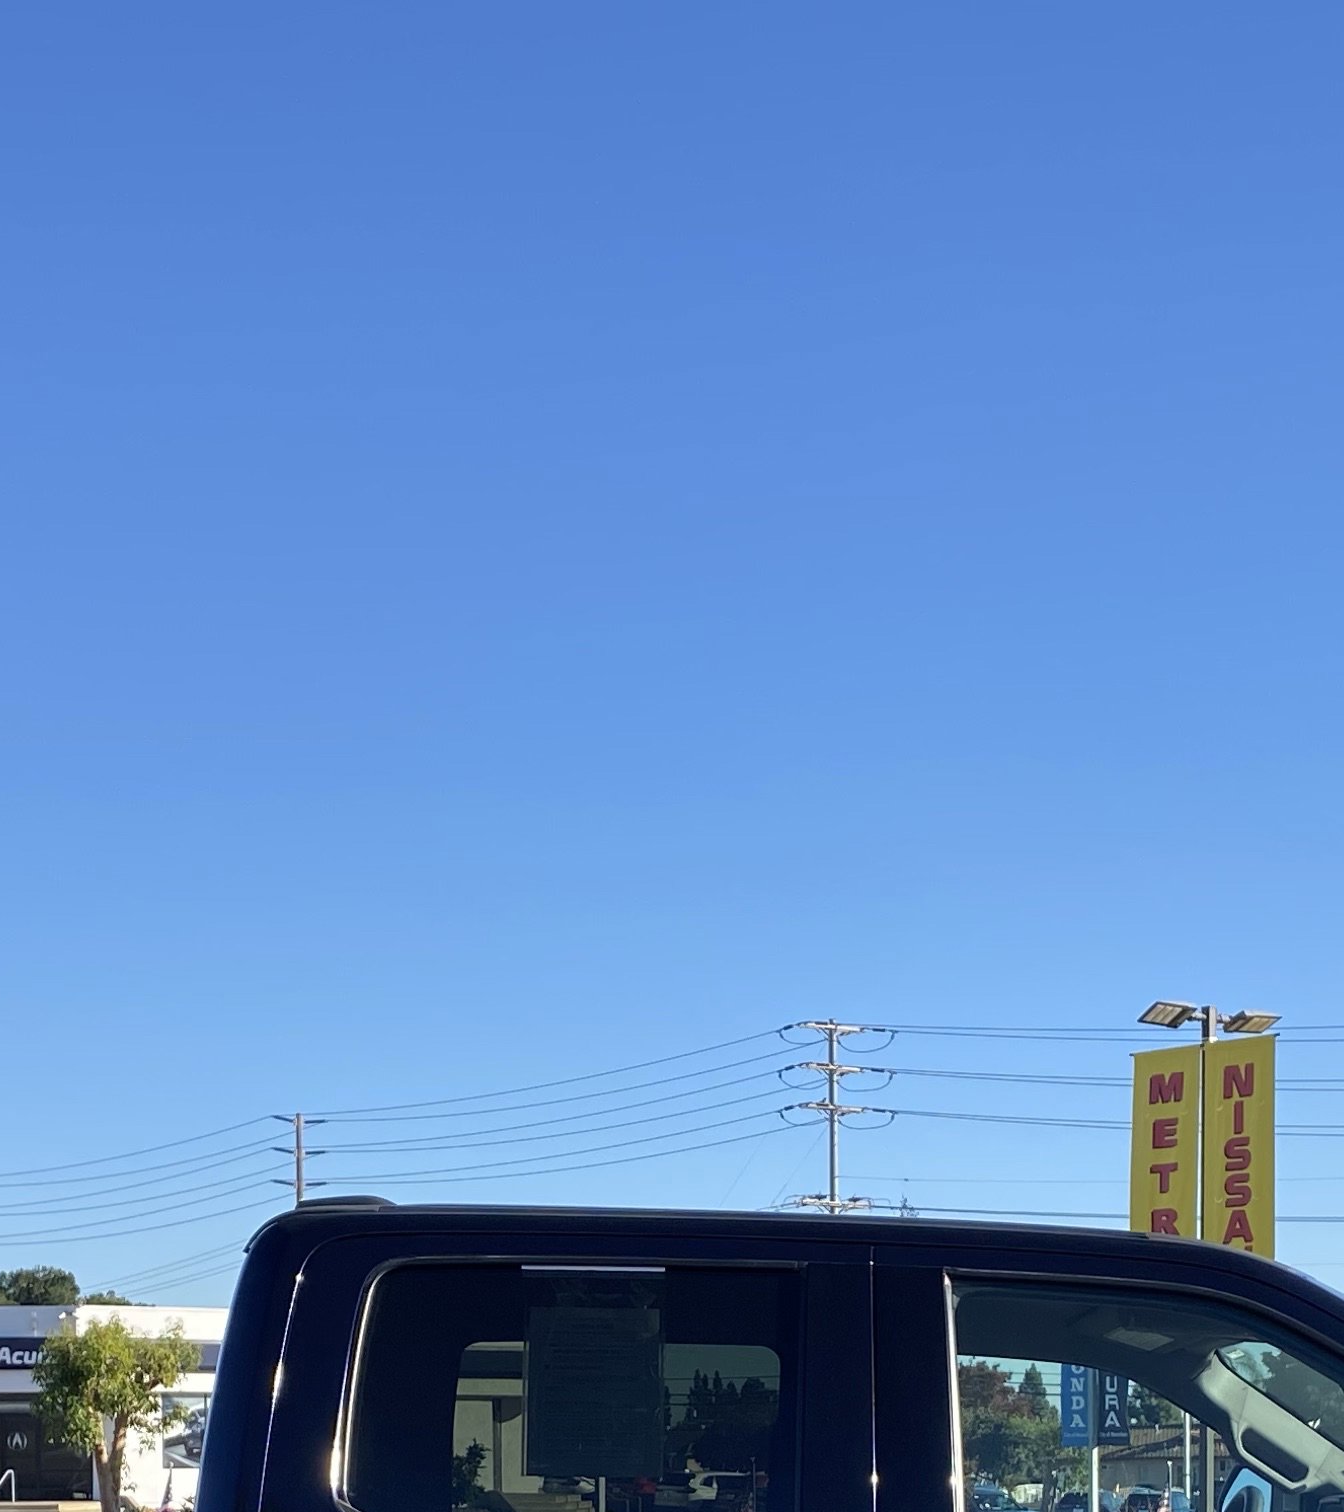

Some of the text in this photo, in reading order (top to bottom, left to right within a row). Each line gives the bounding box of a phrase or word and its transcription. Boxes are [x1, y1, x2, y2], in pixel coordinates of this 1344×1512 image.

[1149, 1071, 1184, 1236] METR
[1223, 1063, 1254, 1252] NISSA
[1070, 1365, 1086, 1428] ONDA
[1104, 1375, 1121, 1428] URA
